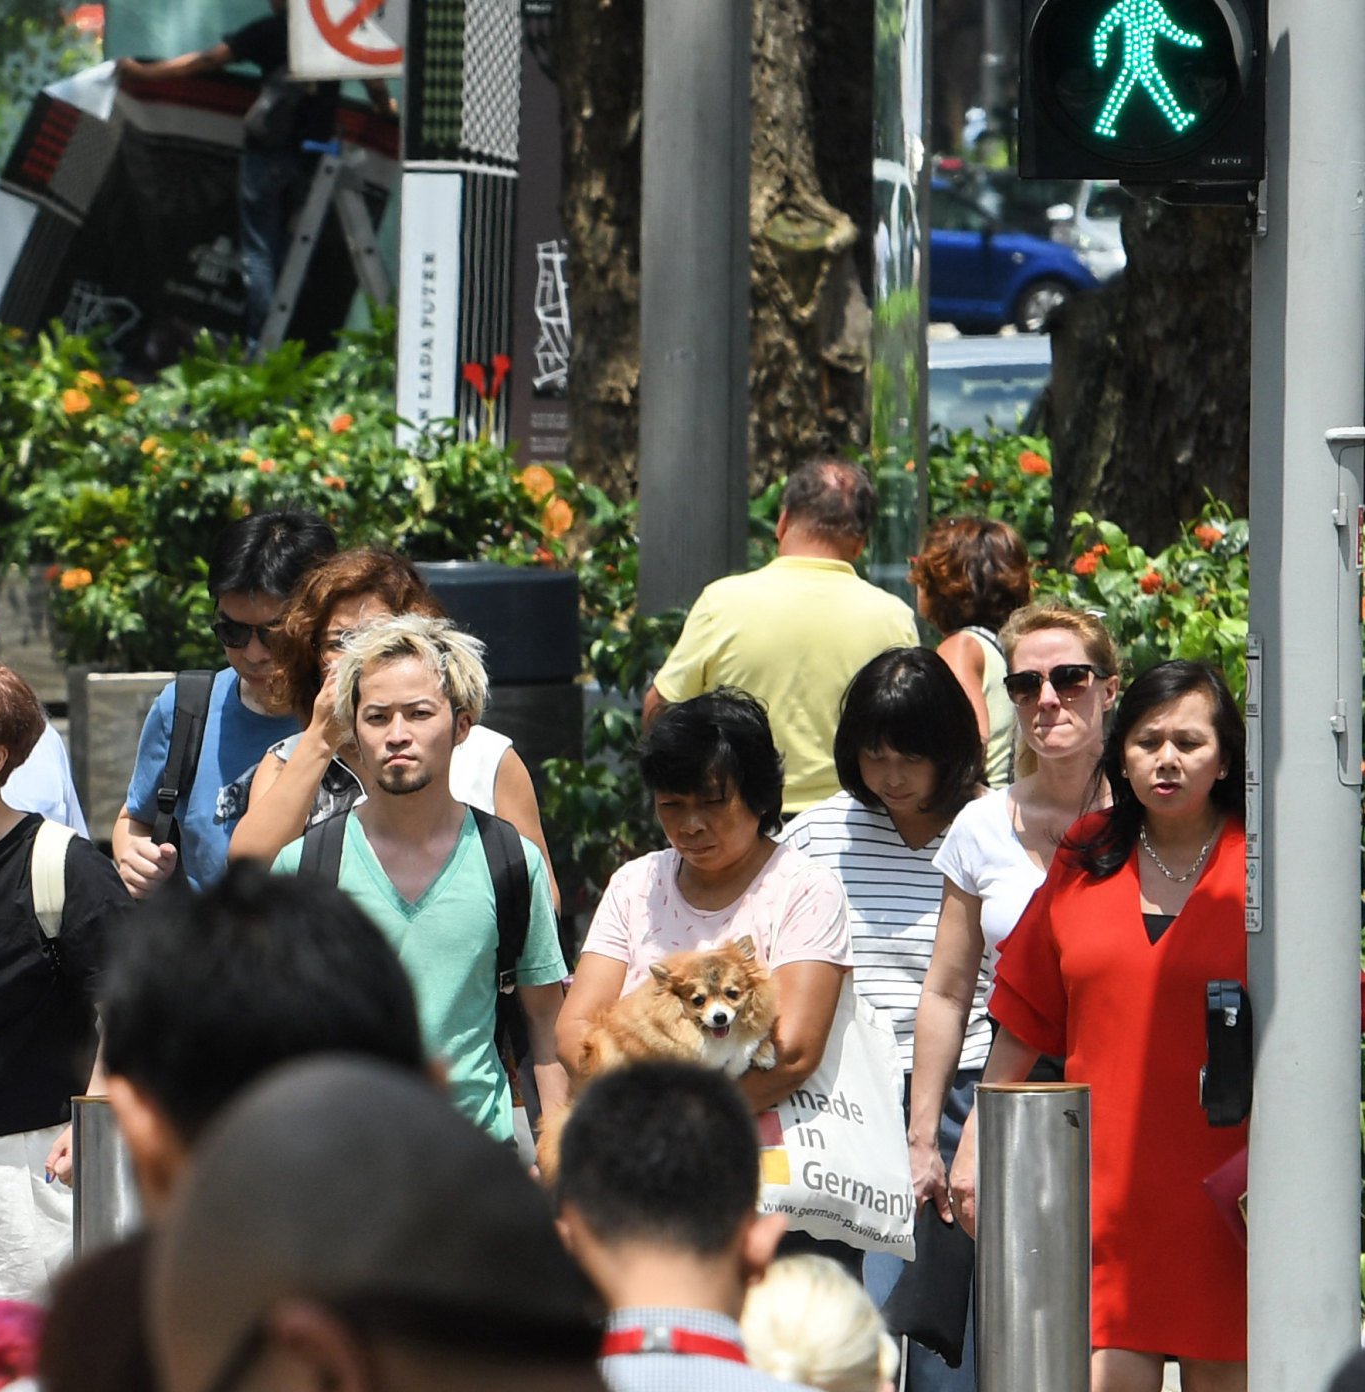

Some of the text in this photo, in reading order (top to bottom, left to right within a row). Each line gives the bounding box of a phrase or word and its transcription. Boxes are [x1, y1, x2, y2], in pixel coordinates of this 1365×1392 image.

[790, 1089, 864, 1125] made
[795, 1118, 826, 1150] in
[803, 1161, 914, 1225] Germany
